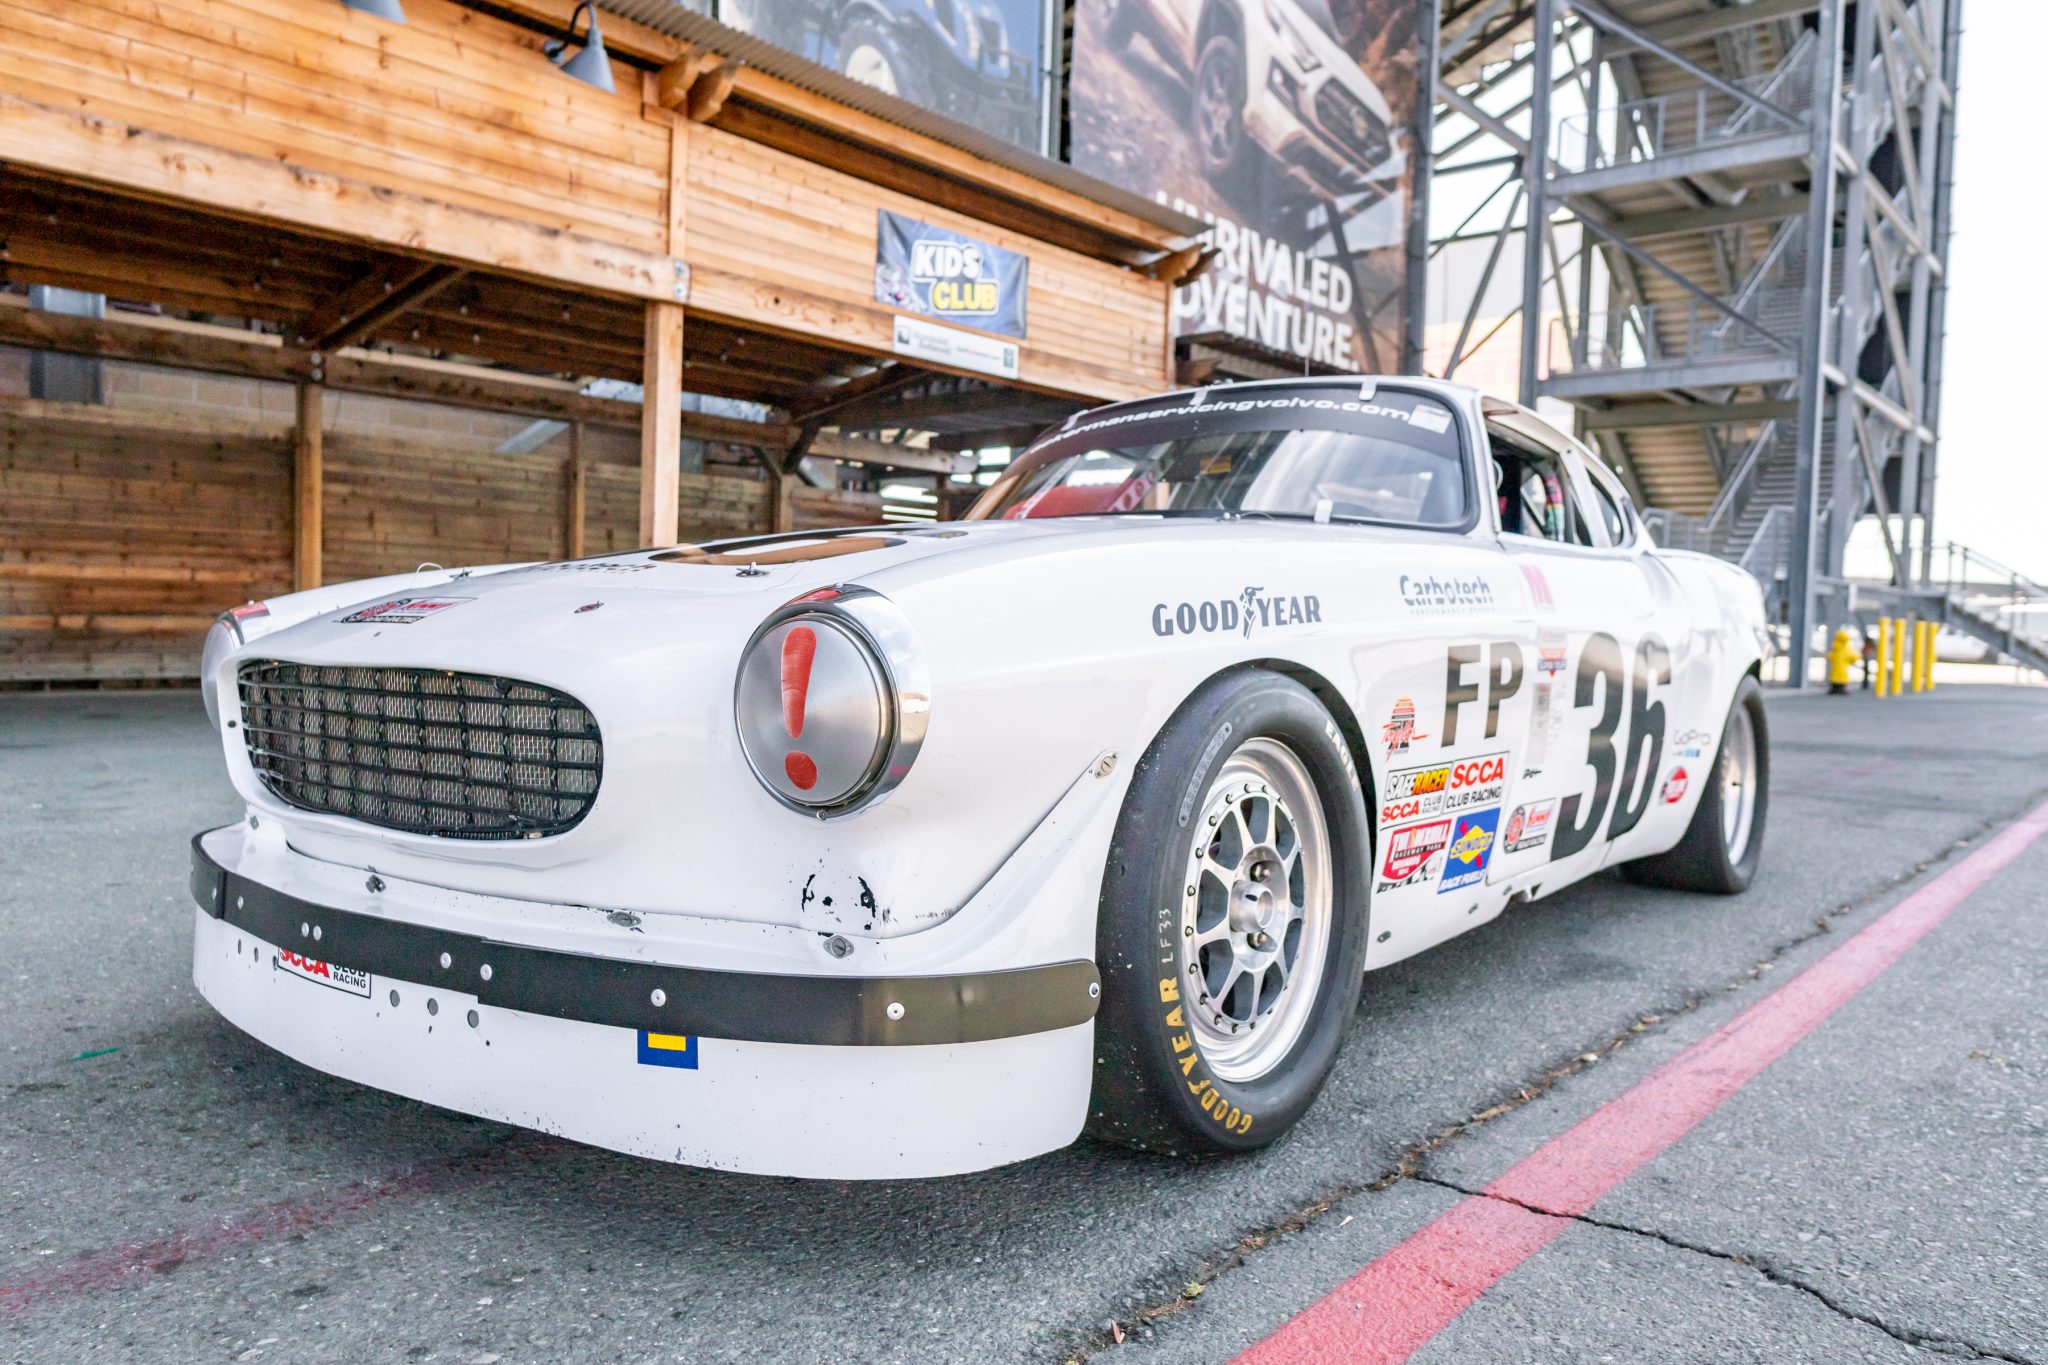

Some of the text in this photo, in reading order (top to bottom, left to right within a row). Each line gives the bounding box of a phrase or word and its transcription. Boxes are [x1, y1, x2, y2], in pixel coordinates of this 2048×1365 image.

[913, 245, 981, 279] KIDS
[932, 281, 998, 311] CLUB
[1173, 271, 1361, 373] DVENTURE.
[1440, 641, 1524, 748] FP
[1325, 719, 1359, 793] EAGLE
[1550, 631, 1672, 862] 36
[1451, 757, 1503, 789] SCCA
[1381, 799, 1419, 823] SCCA
[1423, 795, 1442, 807] CLUB
[1446, 786, 1502, 808] CLUB RACING
[1449, 832, 1494, 859] SUNOCO
[333, 971, 367, 988] RACING
